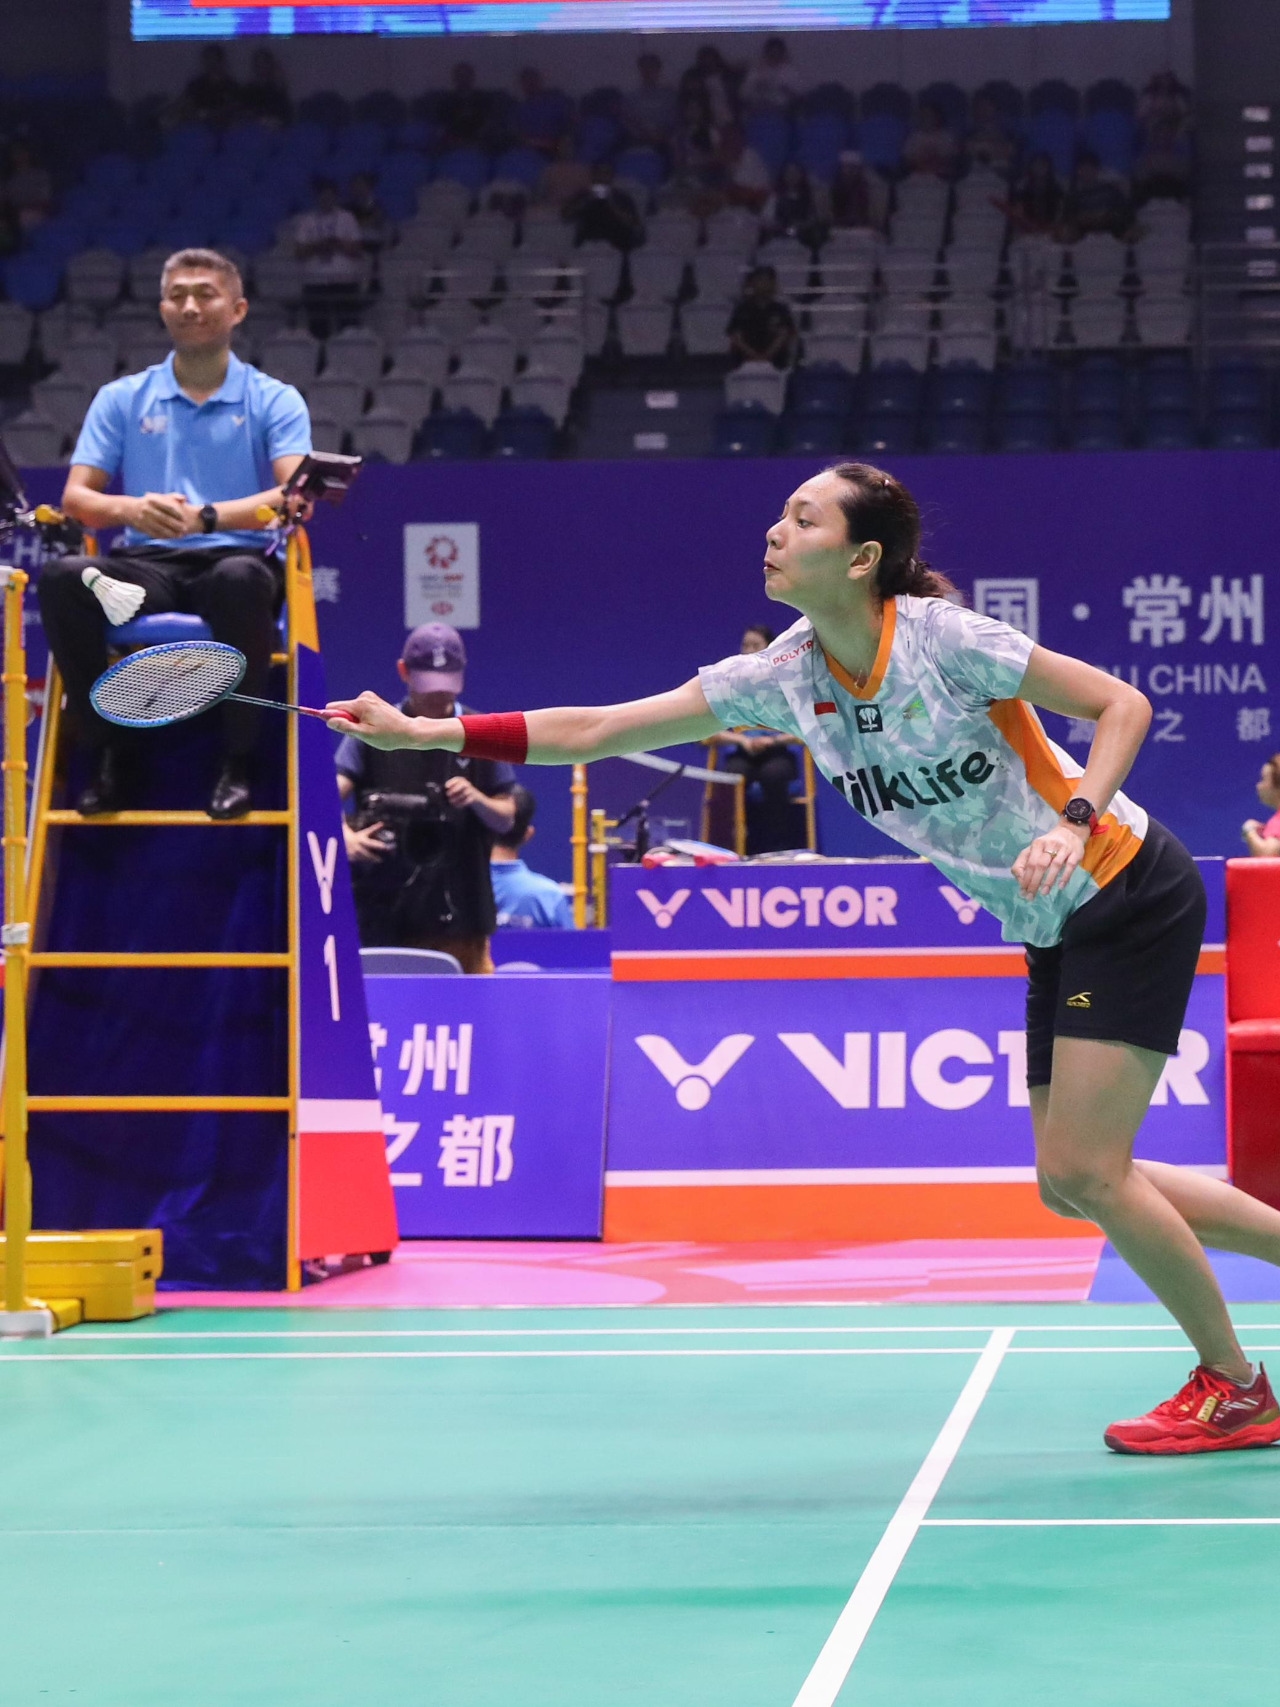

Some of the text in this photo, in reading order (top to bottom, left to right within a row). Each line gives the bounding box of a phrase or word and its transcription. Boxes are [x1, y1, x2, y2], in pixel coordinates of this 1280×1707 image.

[1148, 662, 1267, 696] CHINA
[700, 885, 899, 928] VICTOR
[777, 1028, 1211, 1111] VICTR
